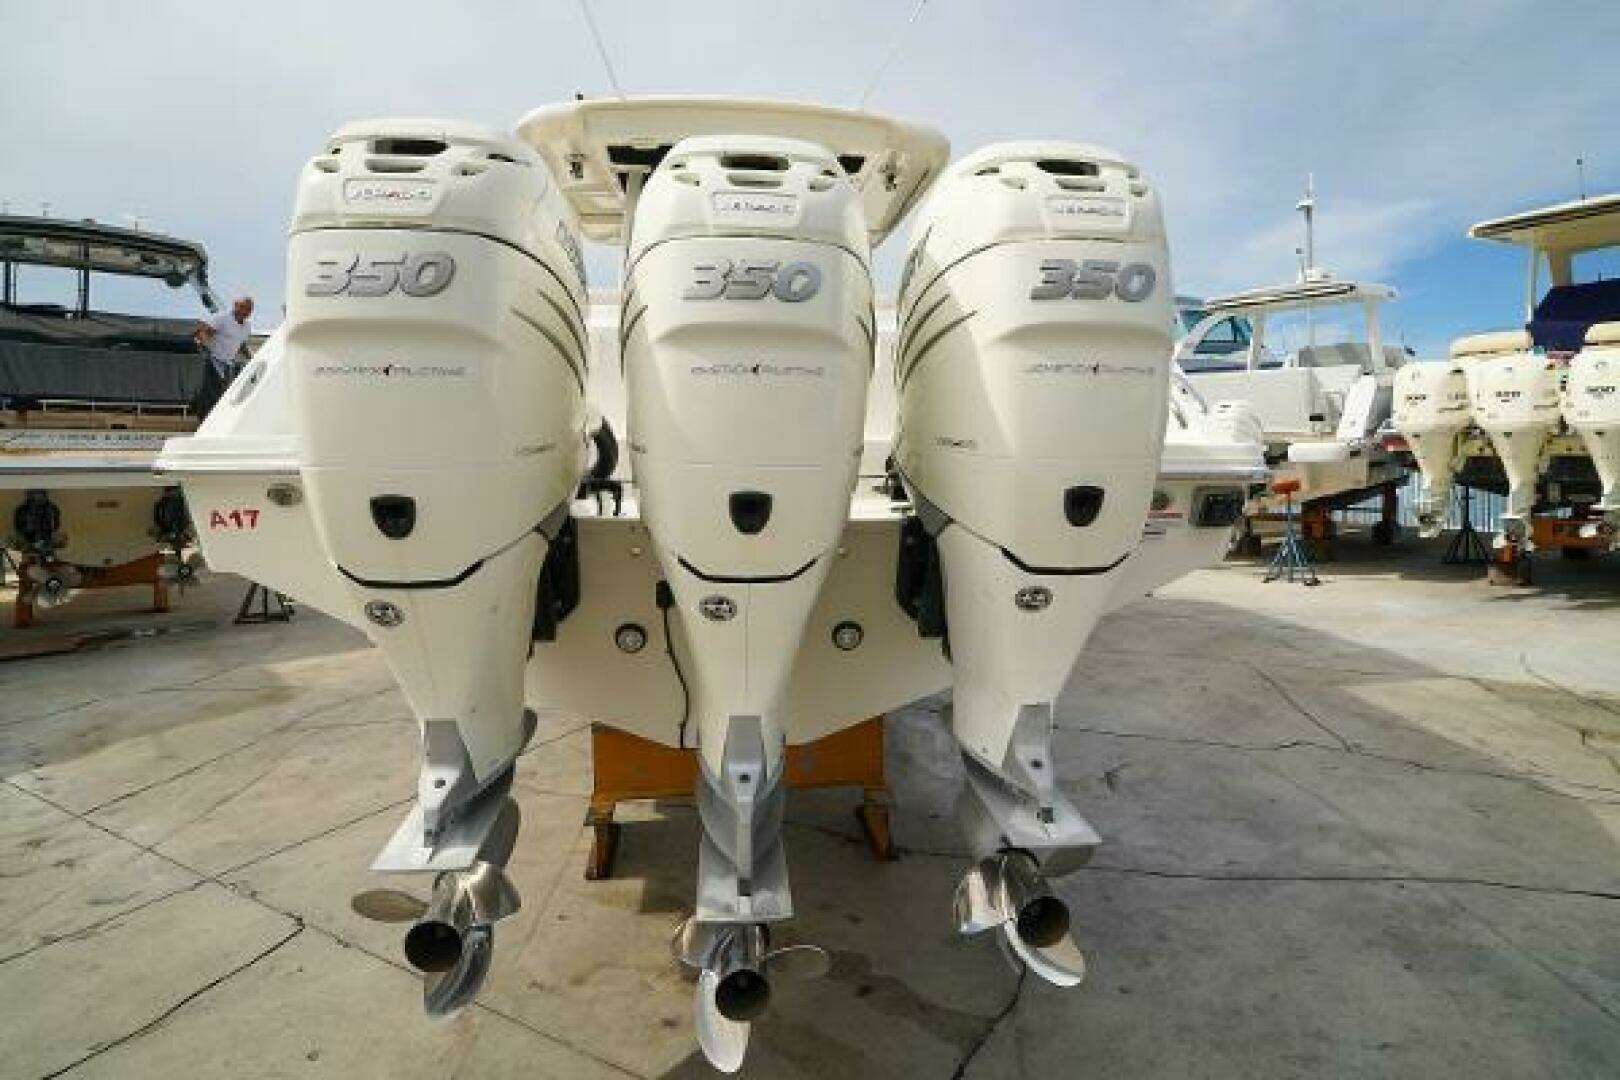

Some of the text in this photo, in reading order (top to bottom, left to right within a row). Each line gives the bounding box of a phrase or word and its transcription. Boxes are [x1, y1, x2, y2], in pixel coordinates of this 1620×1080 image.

[305, 251, 456, 298] 350
[681, 256, 822, 303] 350
[1030, 258, 1156, 303] 350
[210, 508, 260, 530] A17
